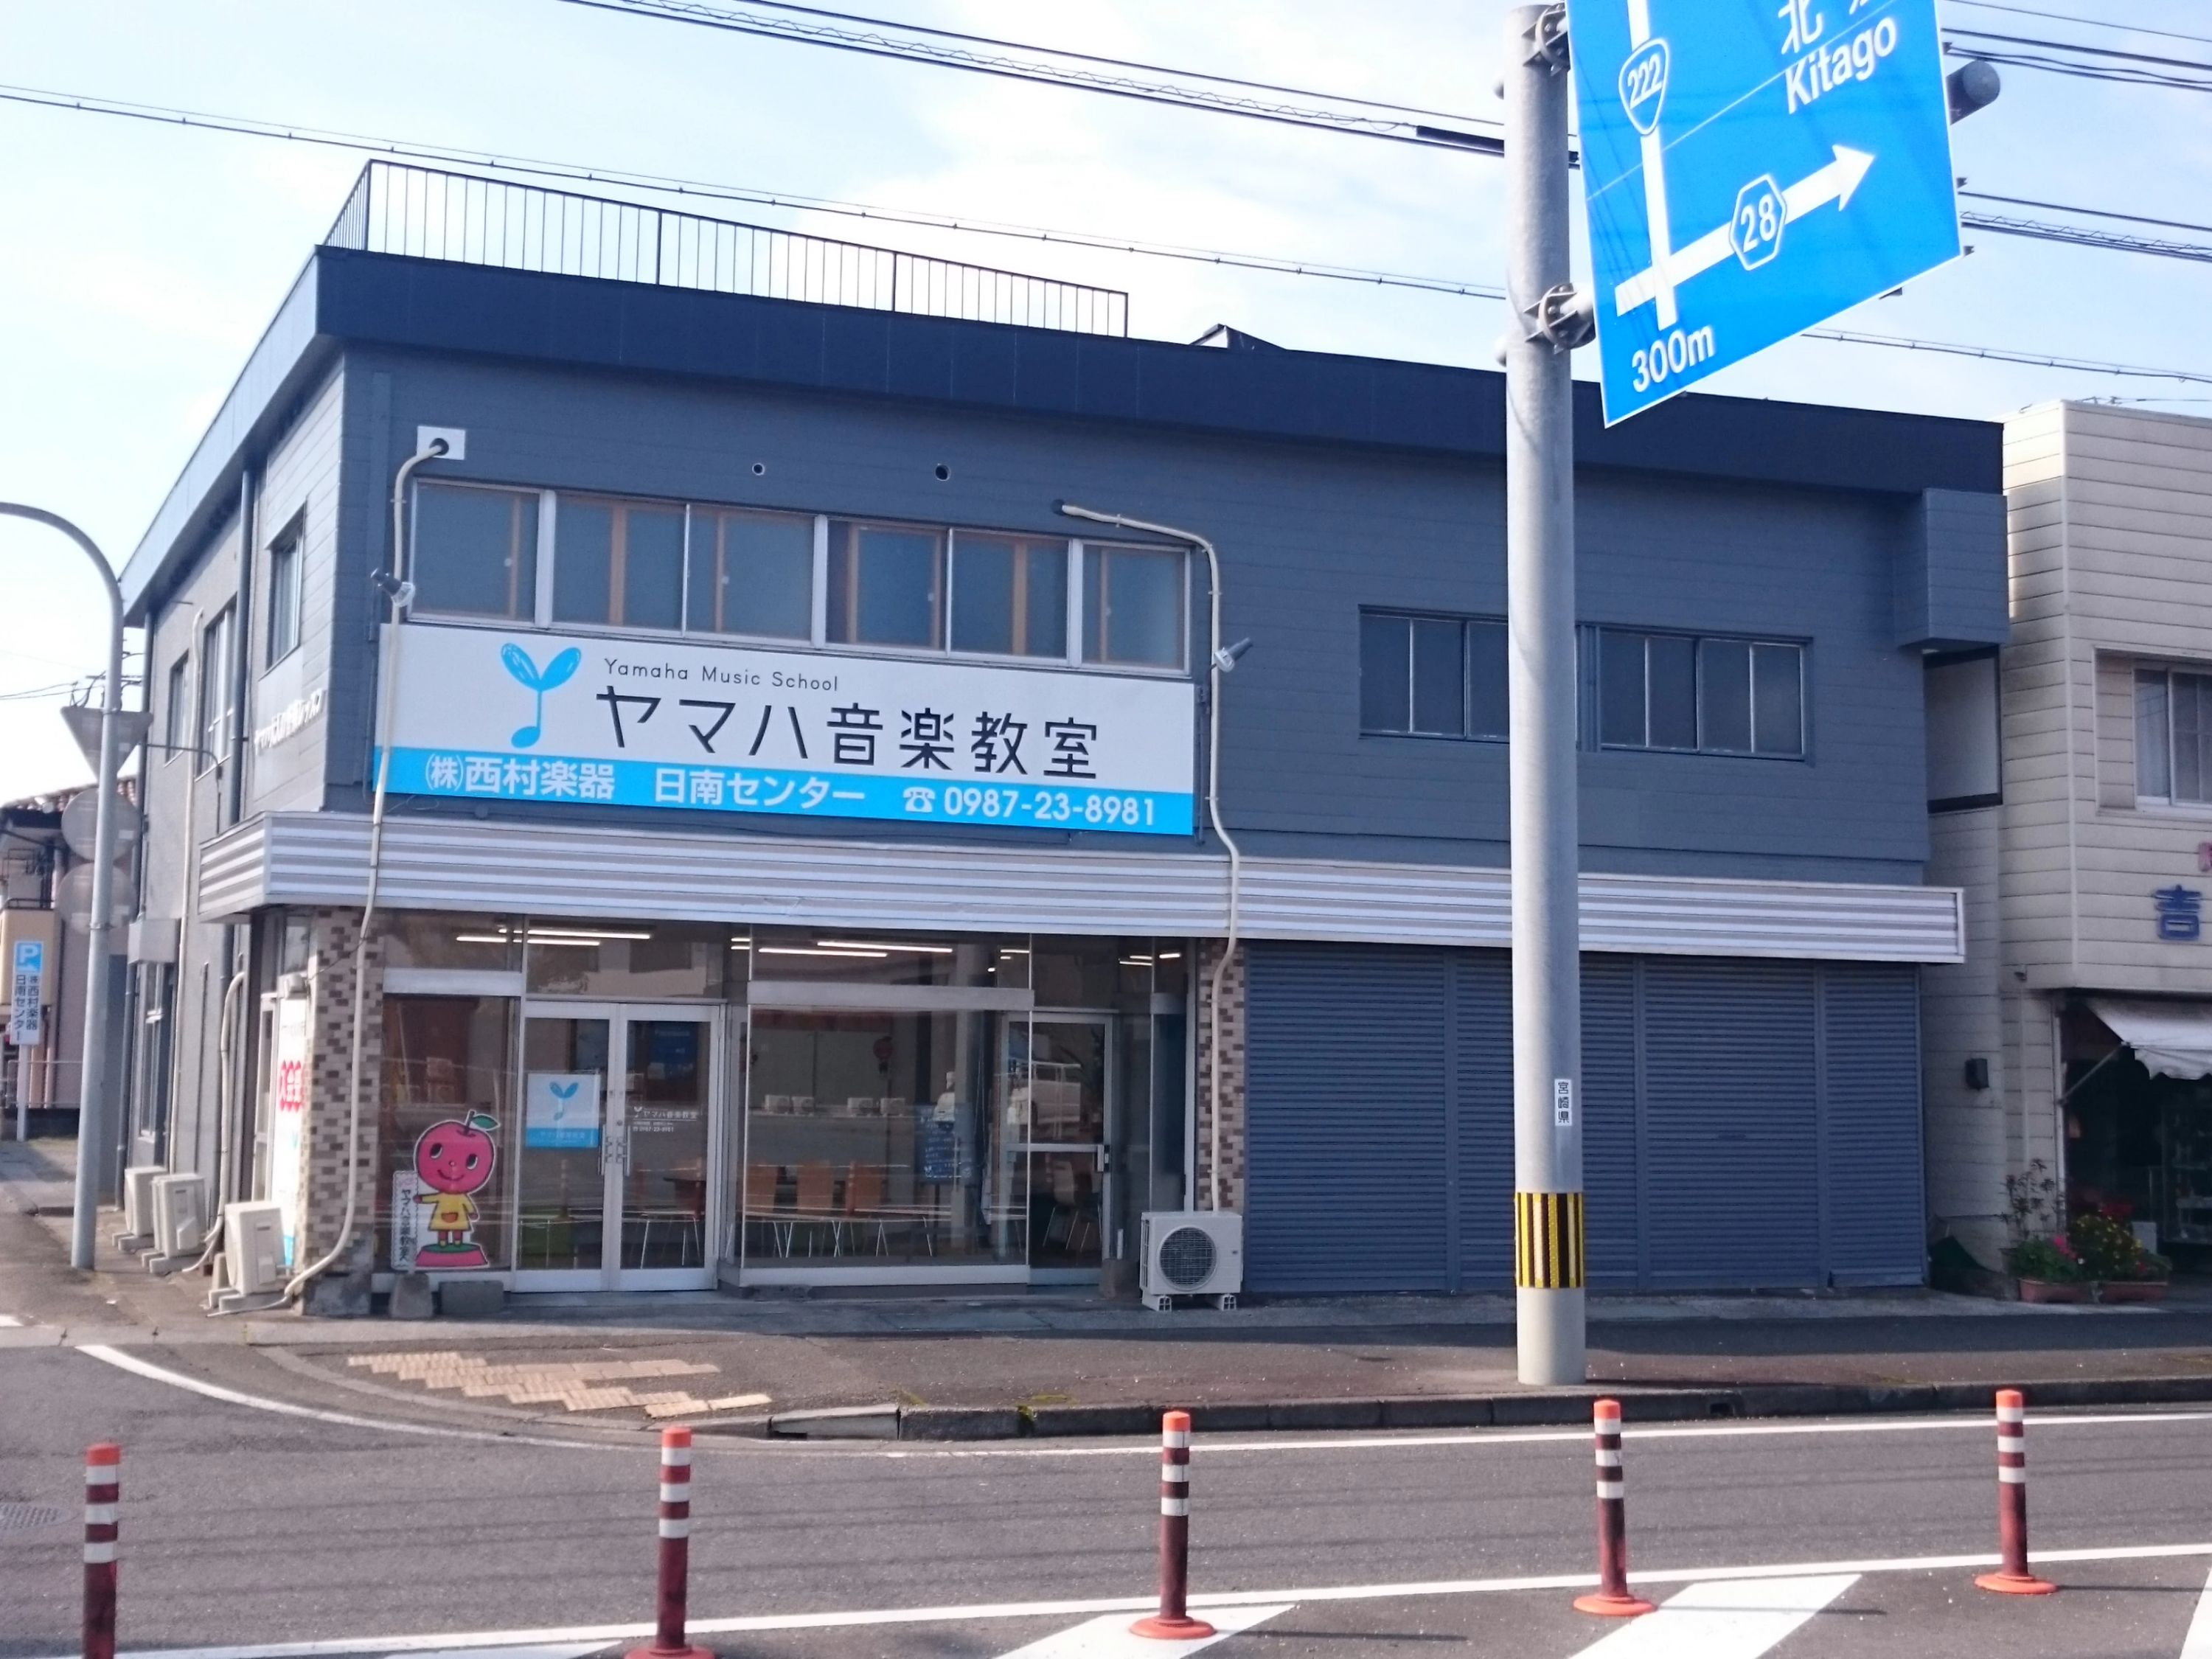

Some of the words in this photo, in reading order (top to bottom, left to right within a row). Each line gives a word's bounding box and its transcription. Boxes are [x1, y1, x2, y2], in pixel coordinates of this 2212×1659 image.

[1627, 53, 1663, 109] 222
[1785, 17, 1897, 114] Kitago
[1740, 193, 1777, 254] 28
[1632, 324, 1715, 393] 300m
[605, 658, 688, 681] Yamaha
[702, 666, 761, 686] Music
[772, 671, 838, 692] School
[596, 685, 1097, 779] ヤマハ音楽教室
[655, 768, 866, 809] 日南センター
[945, 787, 1155, 825] 0987-23-8981
[2155, 884, 2202, 941] 吉
[19, 945, 38, 964] P
[15, 974, 26, 1041] 日南センター
[1557, 1081, 1570, 1124] 宮崎県
